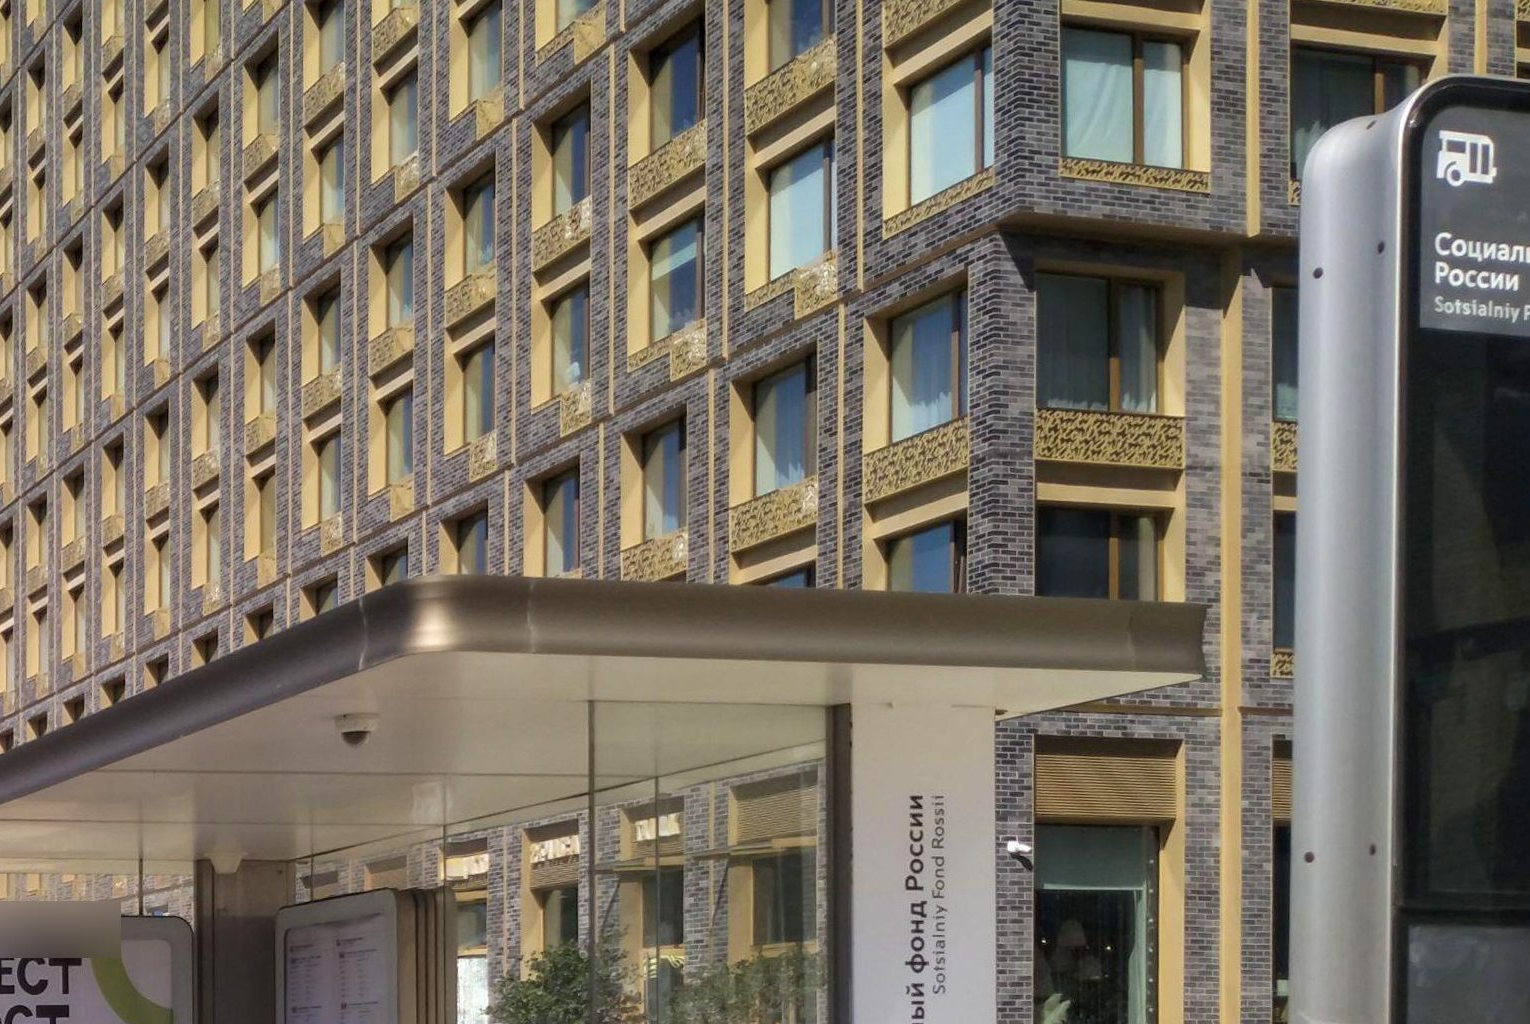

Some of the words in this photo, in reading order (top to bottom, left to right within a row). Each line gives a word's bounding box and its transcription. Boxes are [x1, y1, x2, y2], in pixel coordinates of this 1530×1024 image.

[1435, 261, 1520, 291] России
[1434, 296, 1520, 323] Sotsialniy
[905, 795, 924, 891] России
[931, 795, 945, 849] Rossii
[931, 856, 945, 899] Fond
[905, 901, 929, 974] фонд
[932, 905, 948, 994] Sotsialniy
